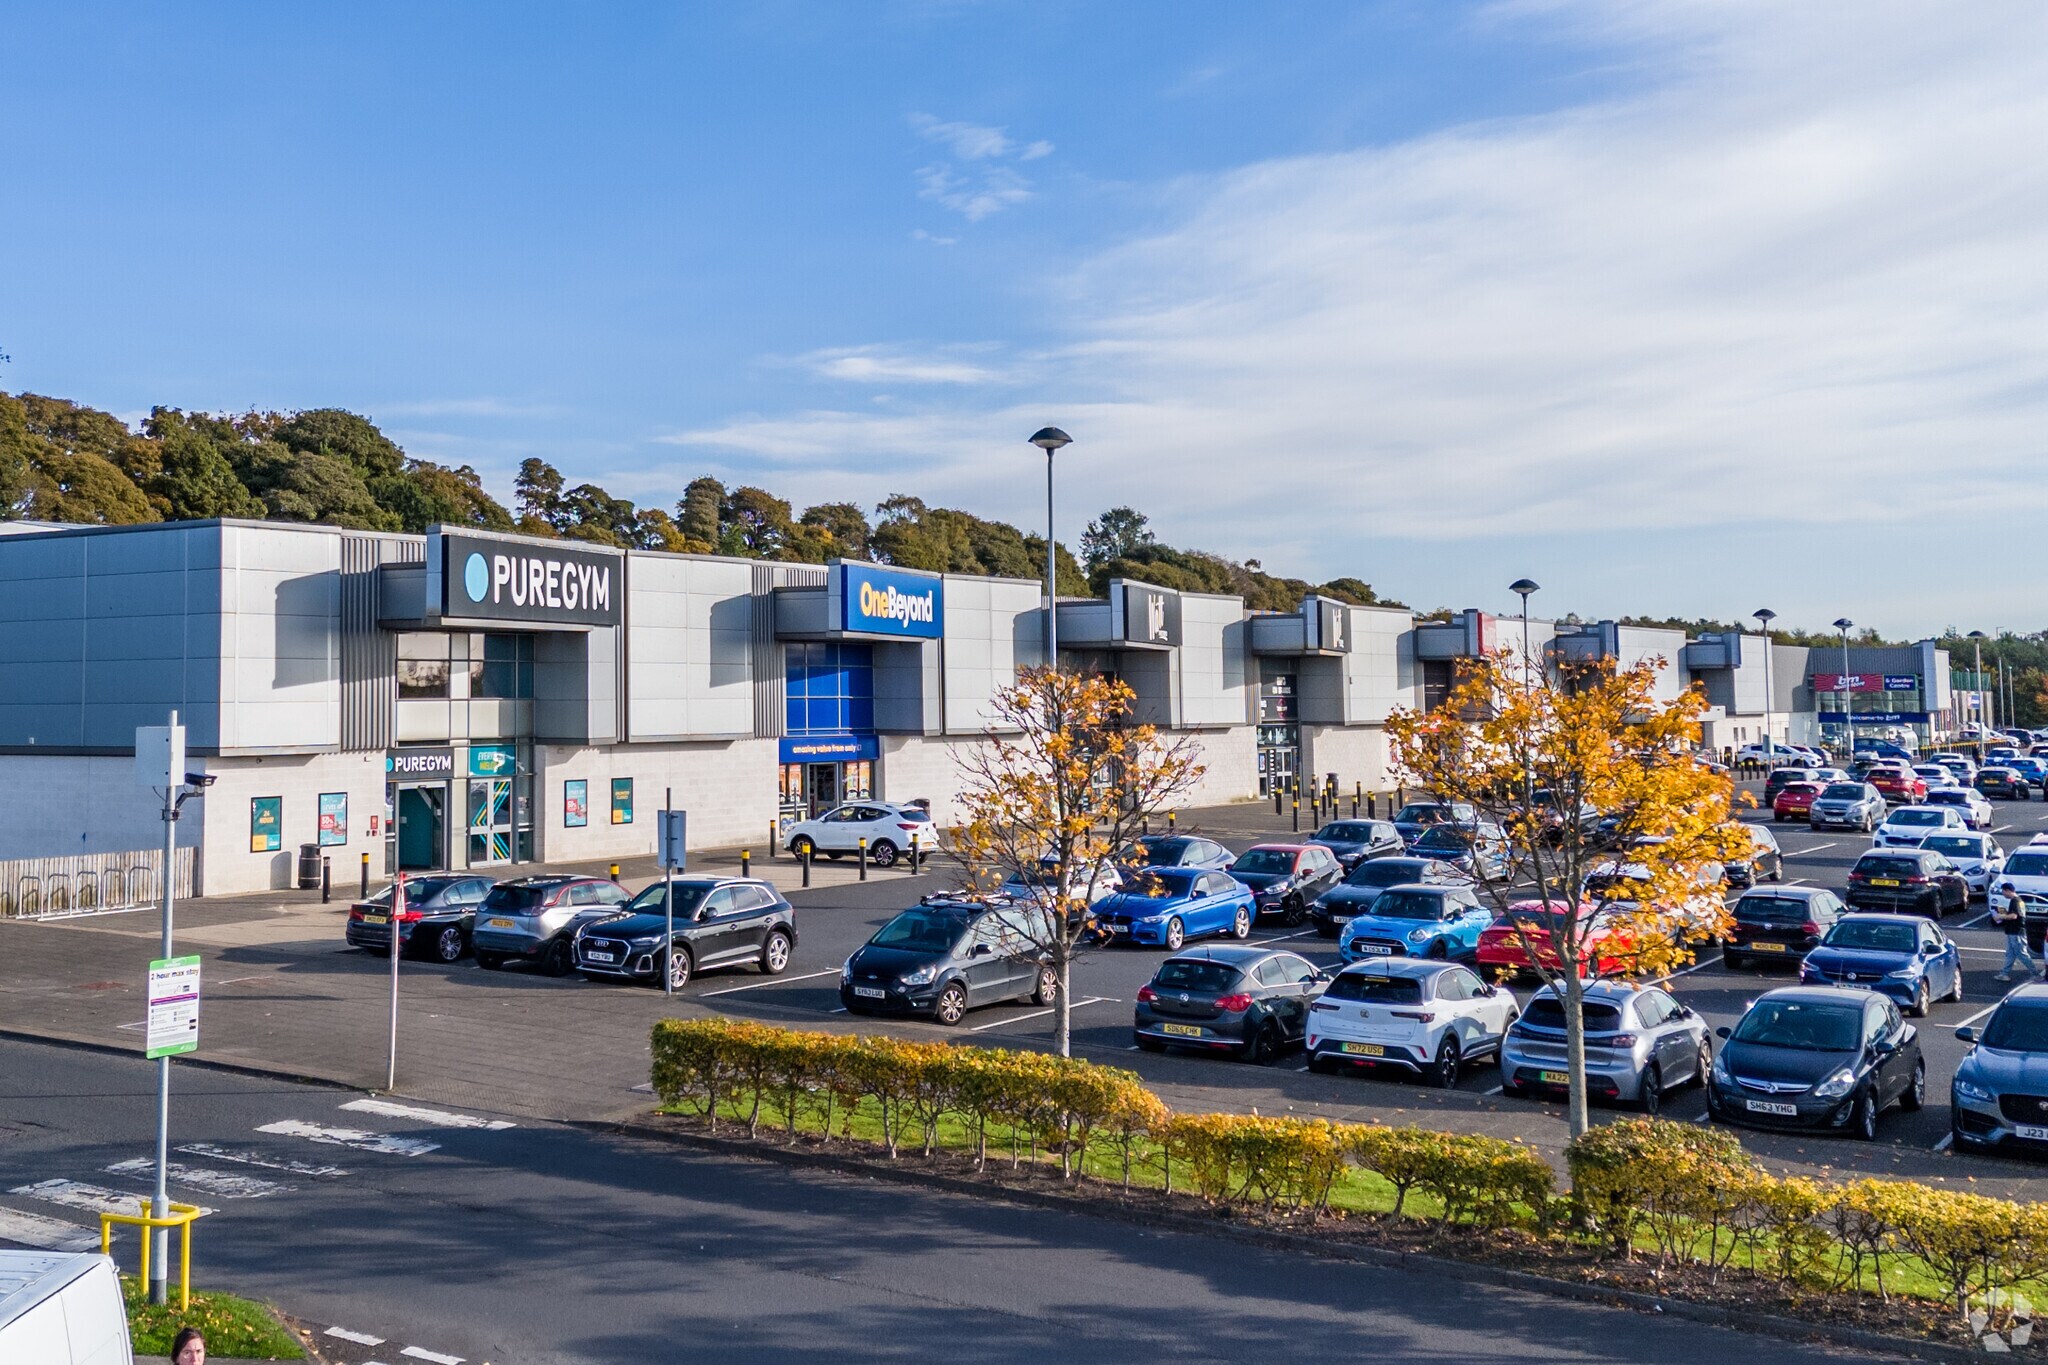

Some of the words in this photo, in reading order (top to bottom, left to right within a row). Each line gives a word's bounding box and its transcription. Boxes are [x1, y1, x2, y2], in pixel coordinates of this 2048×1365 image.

[494, 555, 610, 612] PUREGYM
[860, 581, 933, 629] OneBeyond
[395, 755, 452, 773] PUREGYM
[156, 972, 170, 980] hour
[1347, 1043, 1367, 1053] SH72
[1750, 1101, 1773, 1111] SH63
[1775, 1105, 1793, 1113] YHG
[2024, 1128, 2044, 1138] J23
